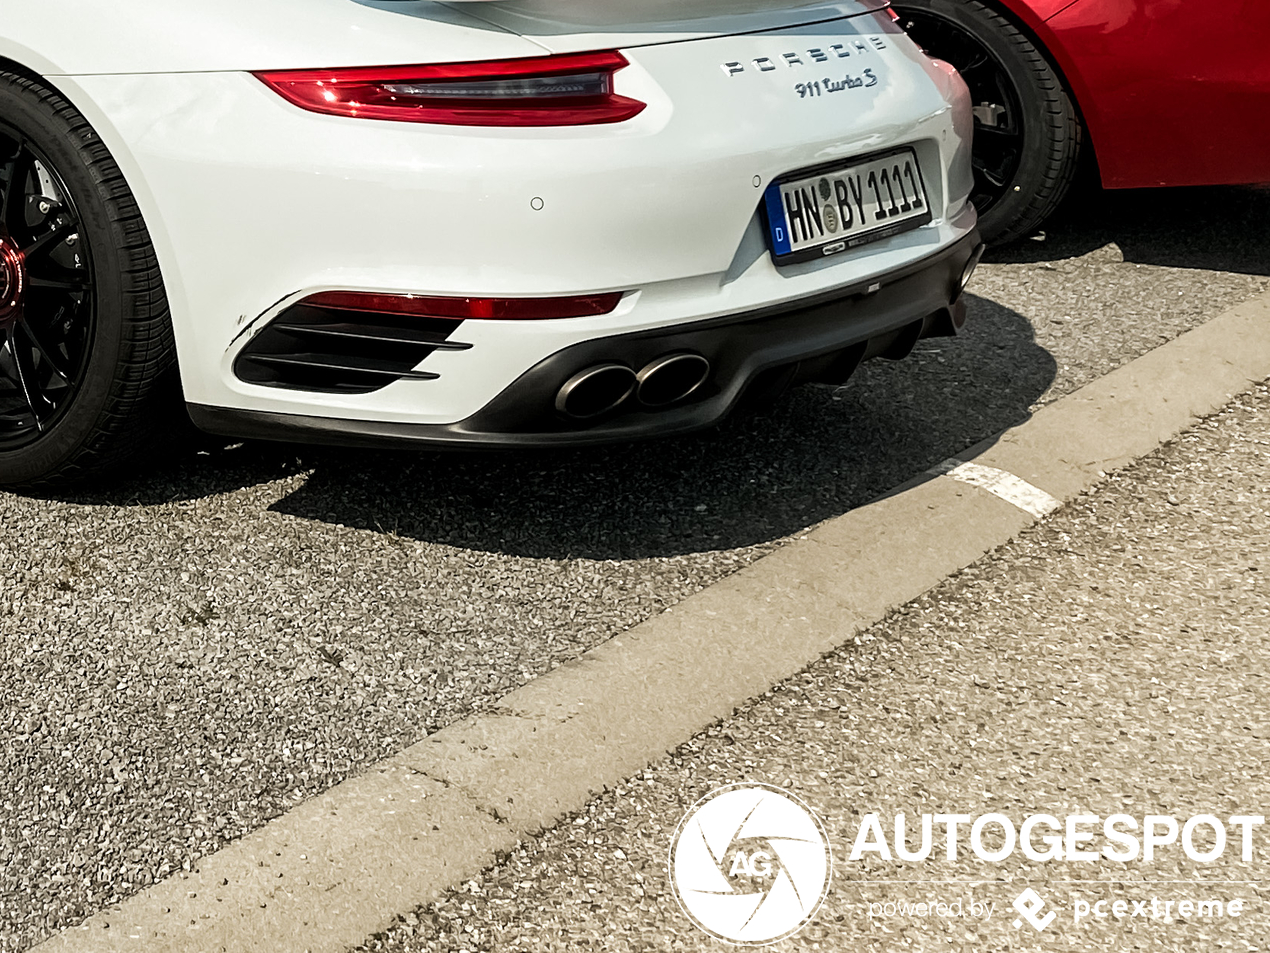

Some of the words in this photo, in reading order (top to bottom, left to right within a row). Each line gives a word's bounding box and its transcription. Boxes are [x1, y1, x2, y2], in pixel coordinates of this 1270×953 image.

[721, 36, 887, 77] PORSCHE
[794, 80, 821, 98] 911
[863, 67, 878, 88] S
[775, 227, 784, 242] D
[784, 184, 825, 244] HN
[834, 174, 866, 231] BY
[867, 160, 923, 221] 1111
